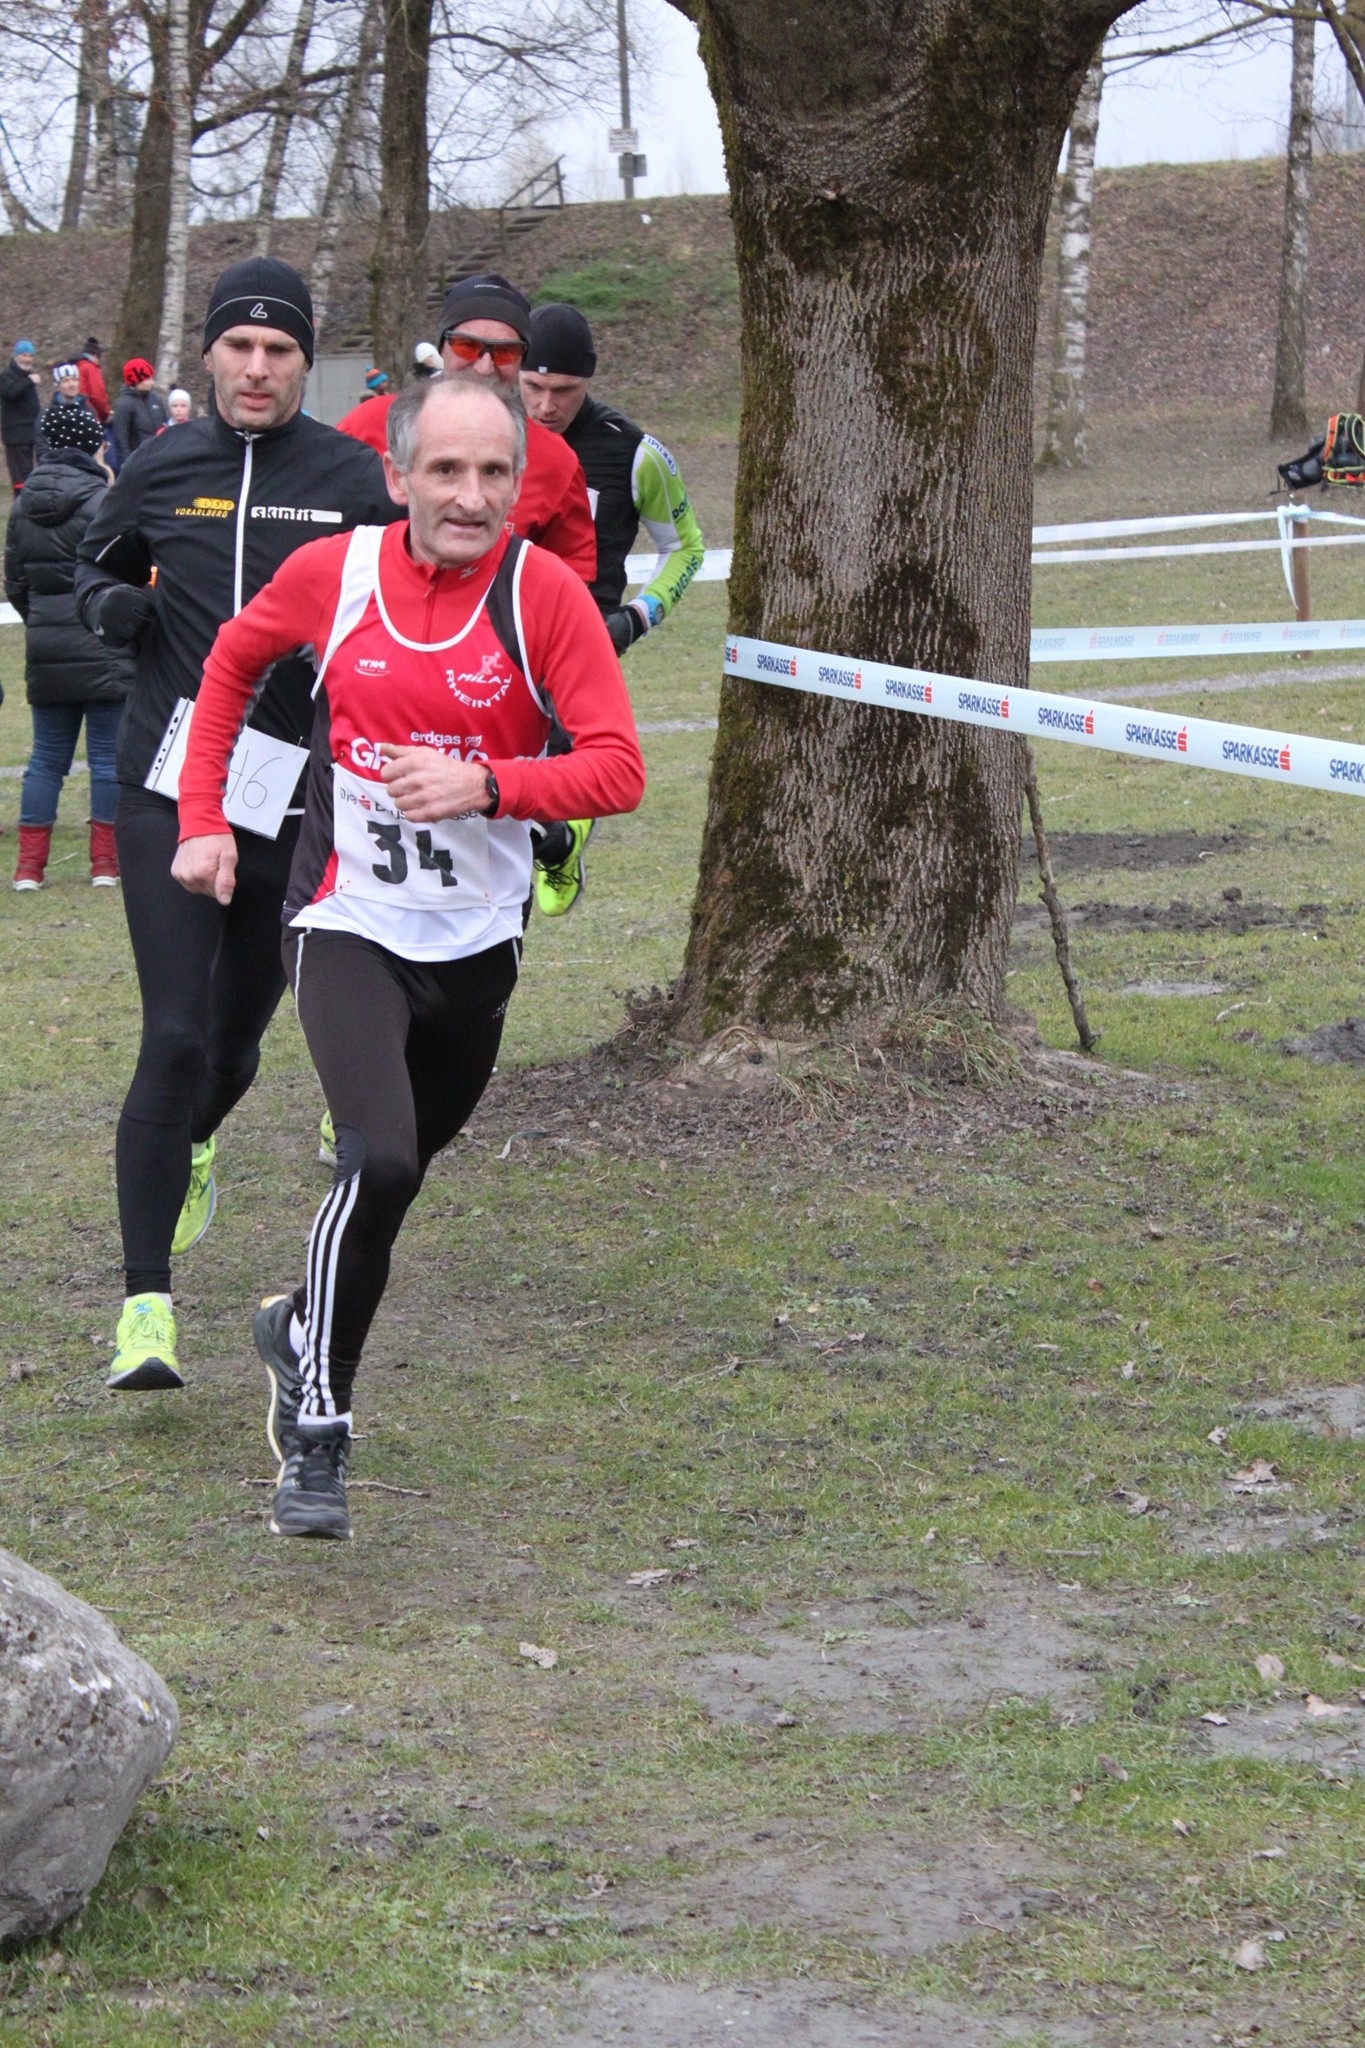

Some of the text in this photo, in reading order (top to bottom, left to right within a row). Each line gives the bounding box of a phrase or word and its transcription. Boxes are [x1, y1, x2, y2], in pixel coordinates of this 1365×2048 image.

[445, 669, 512, 708] RHEINTAL
[457, 673, 502, 684] MILA
[757, 653, 790, 676] SPARKASSE
[818, 666, 855, 688] SPARKASSE
[885, 678, 925, 702] SPARKASSE
[958, 692, 1001, 717] SPARKASSE
[1037, 707, 1086, 733] SPARKASSE
[1125, 723, 1178, 750] SPARKASSE
[1222, 740, 1280, 768] SPARKASSE
[410, 731, 461, 747] erdgas
[366, 820, 458, 888] 34
